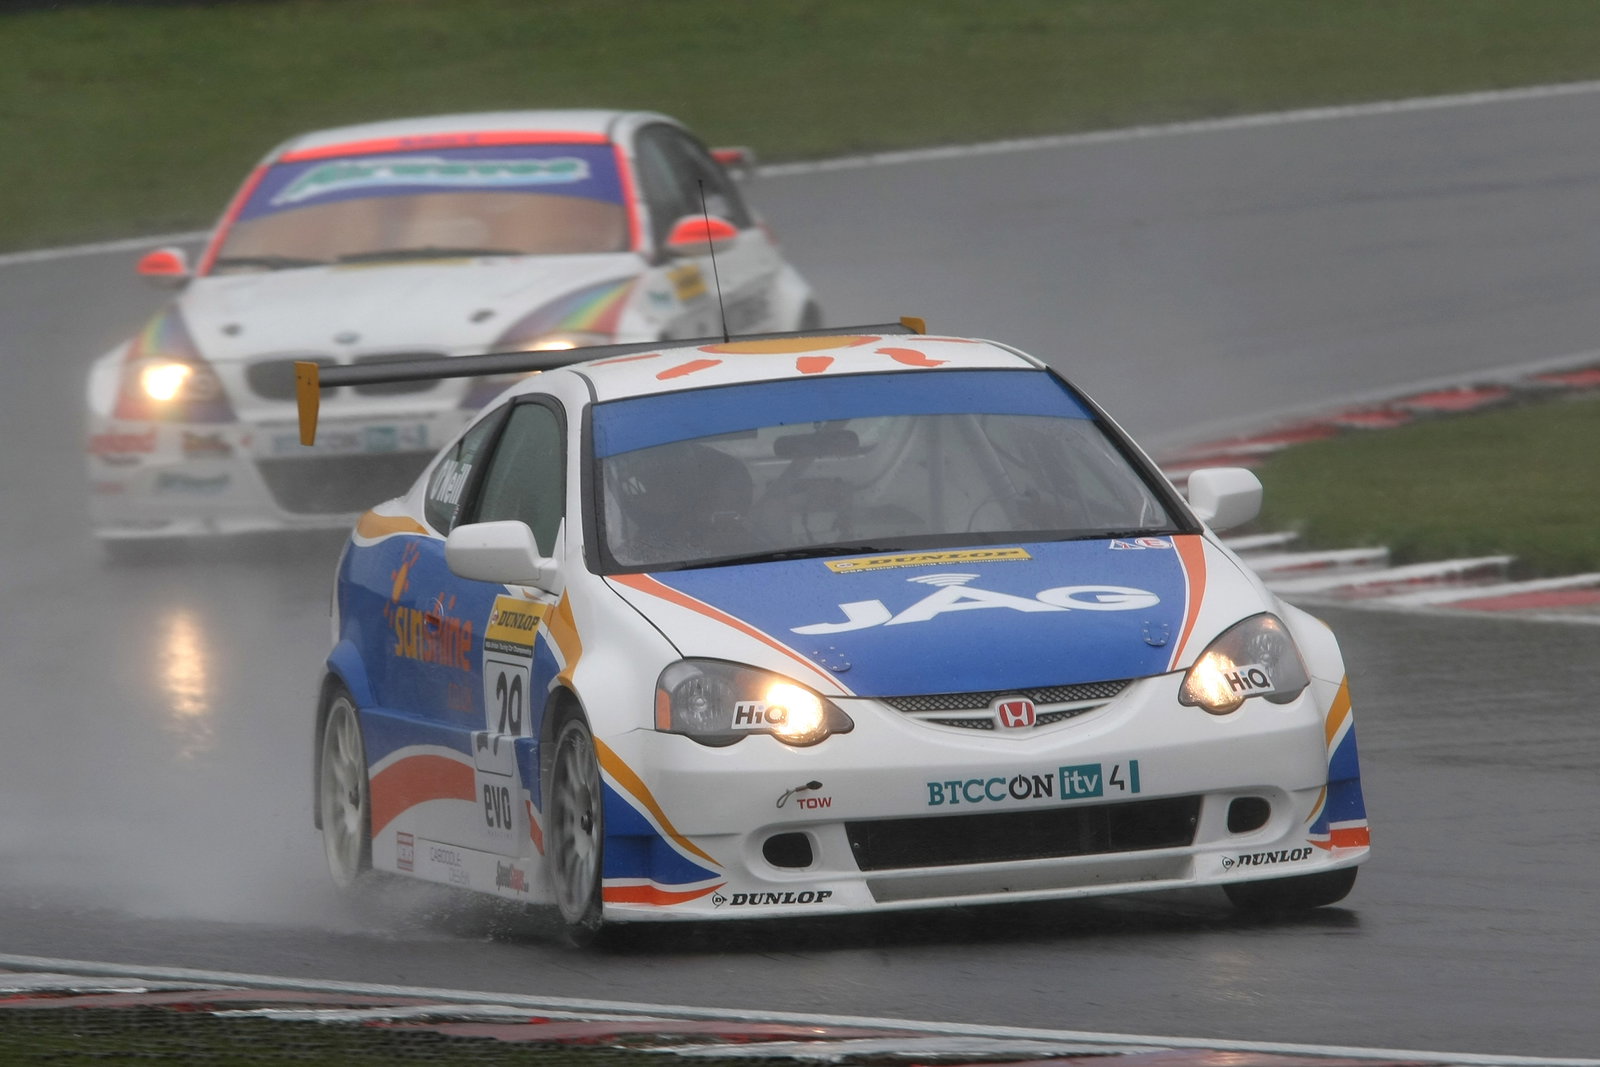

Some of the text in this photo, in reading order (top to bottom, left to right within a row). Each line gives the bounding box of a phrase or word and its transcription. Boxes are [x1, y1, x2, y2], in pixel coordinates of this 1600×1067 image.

[869, 551, 1020, 565] DUNLOP
[789, 585, 1161, 635] JAG
[497, 610, 541, 632] DUNLOP
[1223, 668, 1271, 692] HiQ
[735, 705, 788, 725] HiQ
[1063, 769, 1099, 795] itv
[1109, 764, 1125, 791] 4
[483, 783, 513, 831] evo
[796, 797, 832, 810] TOW
[1236, 847, 1313, 868] DUNLOP
[729, 890, 833, 906] DUNLOP
